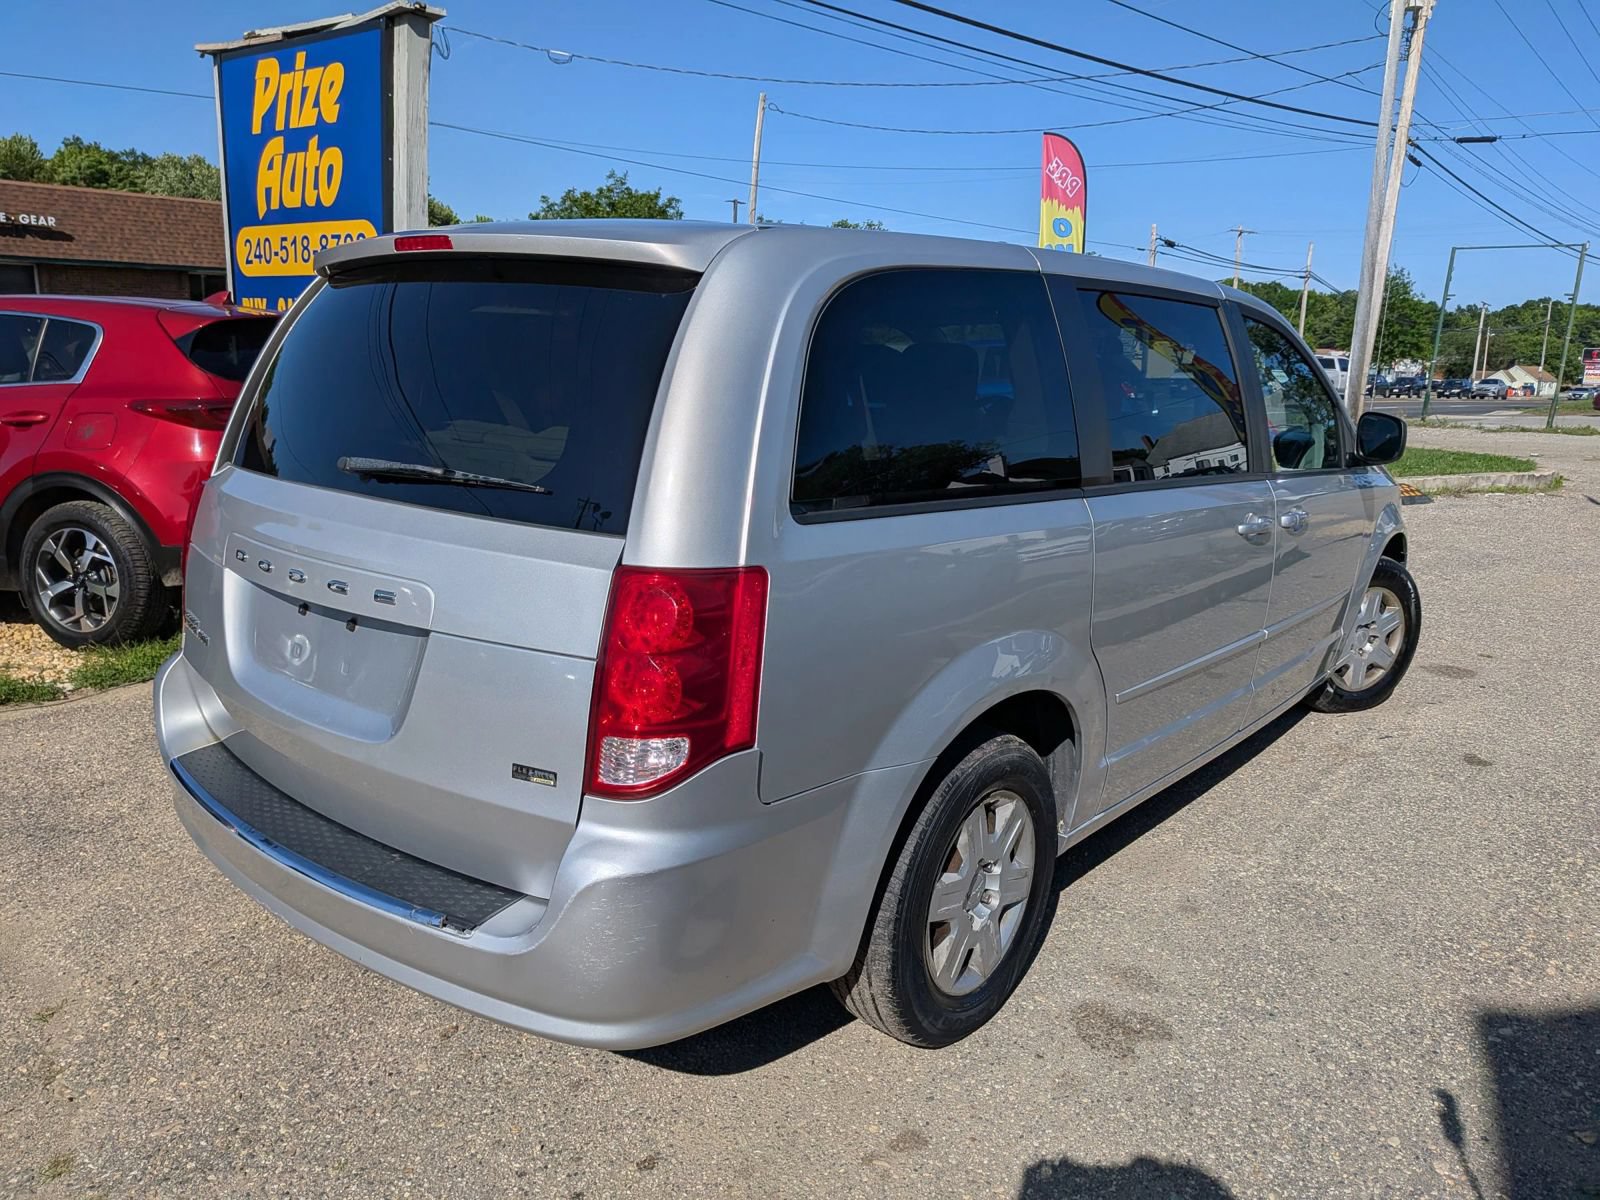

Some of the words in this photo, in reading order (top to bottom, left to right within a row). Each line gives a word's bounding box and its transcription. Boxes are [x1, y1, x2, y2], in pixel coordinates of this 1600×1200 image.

[251, 51, 345, 135] Prize
[256, 134, 343, 220] Auto
[19, 213, 56, 227] GEAR
[244, 232, 366, 265] 240-518-8
[236, 549, 397, 605] DODGE
